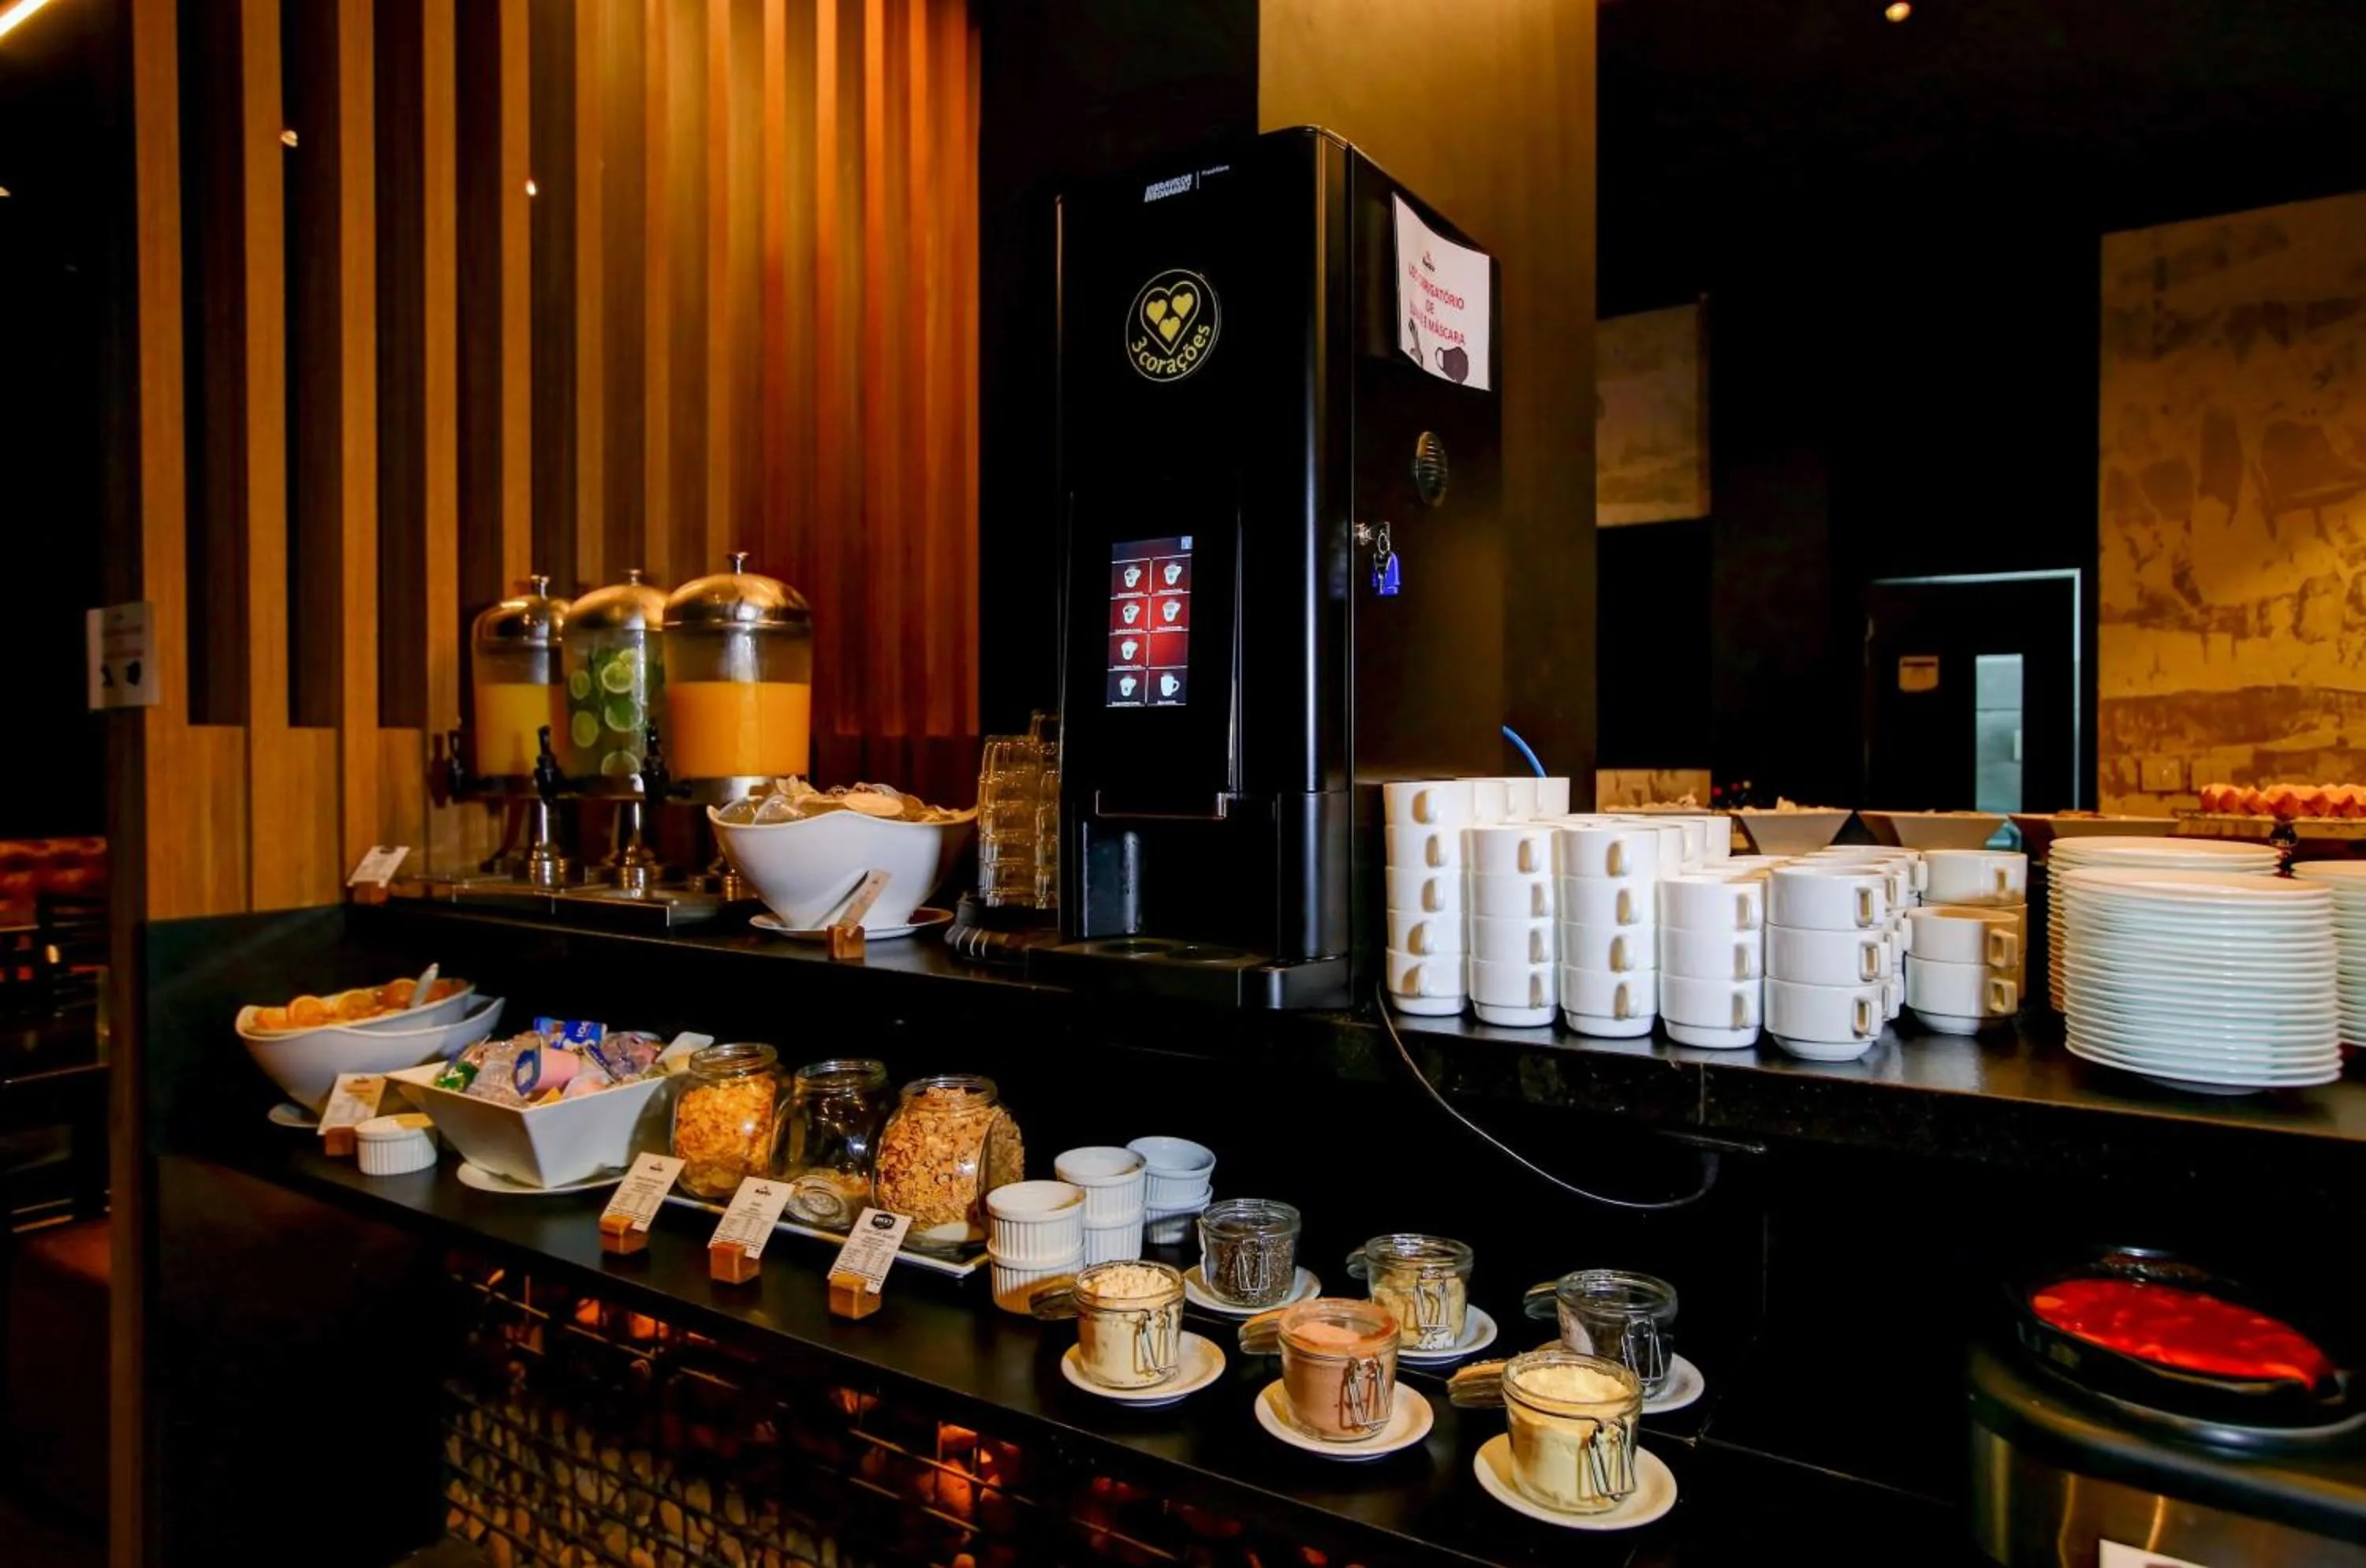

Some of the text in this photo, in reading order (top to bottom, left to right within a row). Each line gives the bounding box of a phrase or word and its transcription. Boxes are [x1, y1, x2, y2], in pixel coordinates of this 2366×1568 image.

[1426, 300, 1435, 315] DE
[1131, 324, 1211, 374] 3 corações
